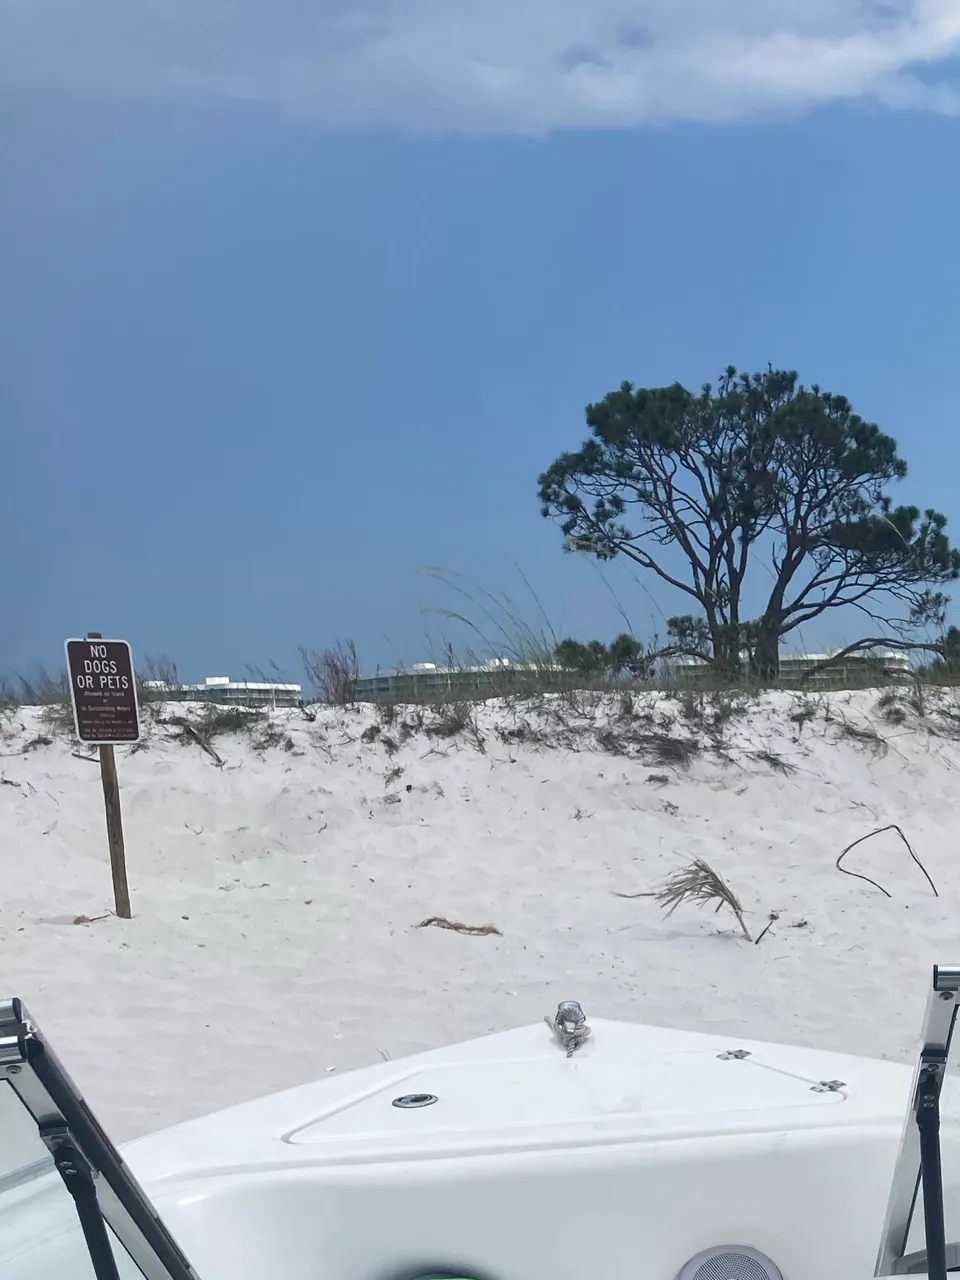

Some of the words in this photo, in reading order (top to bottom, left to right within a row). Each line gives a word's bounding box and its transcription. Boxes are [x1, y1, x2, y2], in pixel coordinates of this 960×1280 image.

[90, 645, 107, 658] NO
[84, 660, 117, 674] DOGS
[77, 675, 94, 689] OR
[100, 675, 129, 689] PETS
